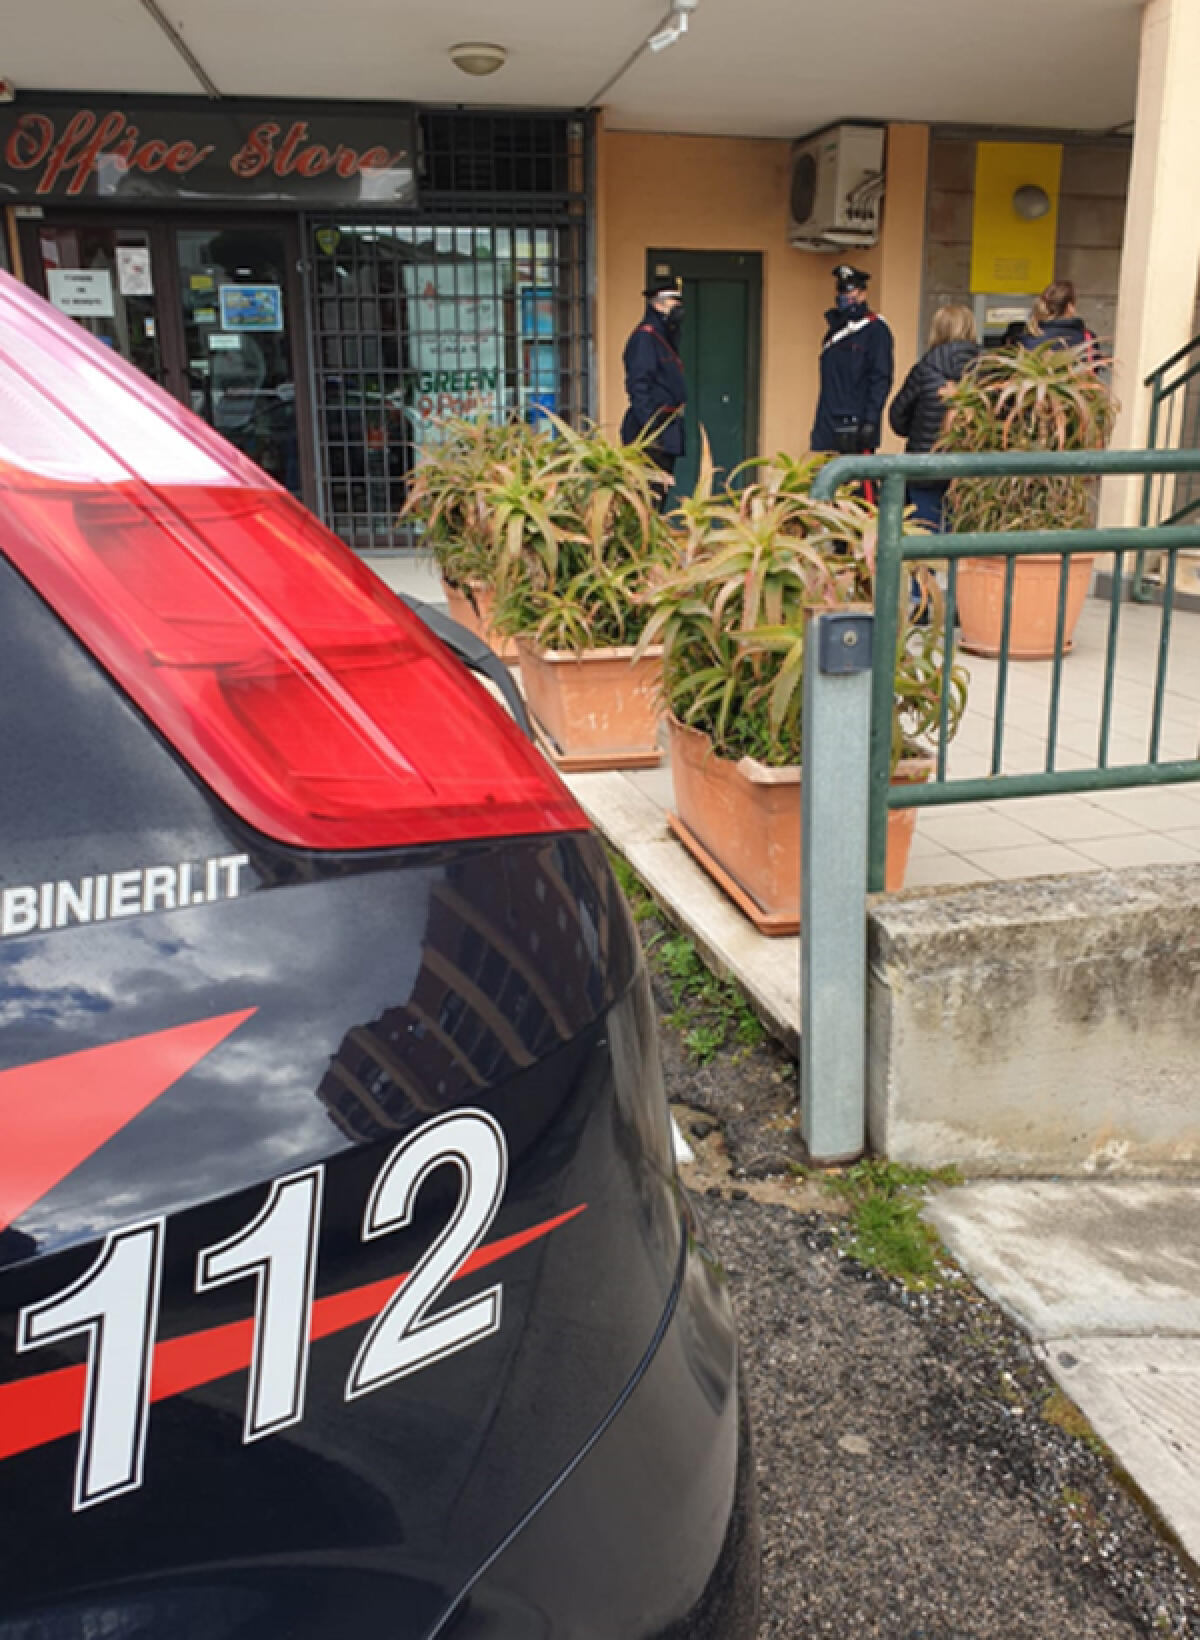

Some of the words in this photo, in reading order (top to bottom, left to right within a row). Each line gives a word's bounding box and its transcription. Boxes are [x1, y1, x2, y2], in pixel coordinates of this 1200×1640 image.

[6, 109, 215, 195] Office
[230, 121, 407, 179] Store
[417, 366, 498, 393] GREEN
[1, 853, 249, 937] BINIERI.IT
[16, 1107, 509, 1512] 112
